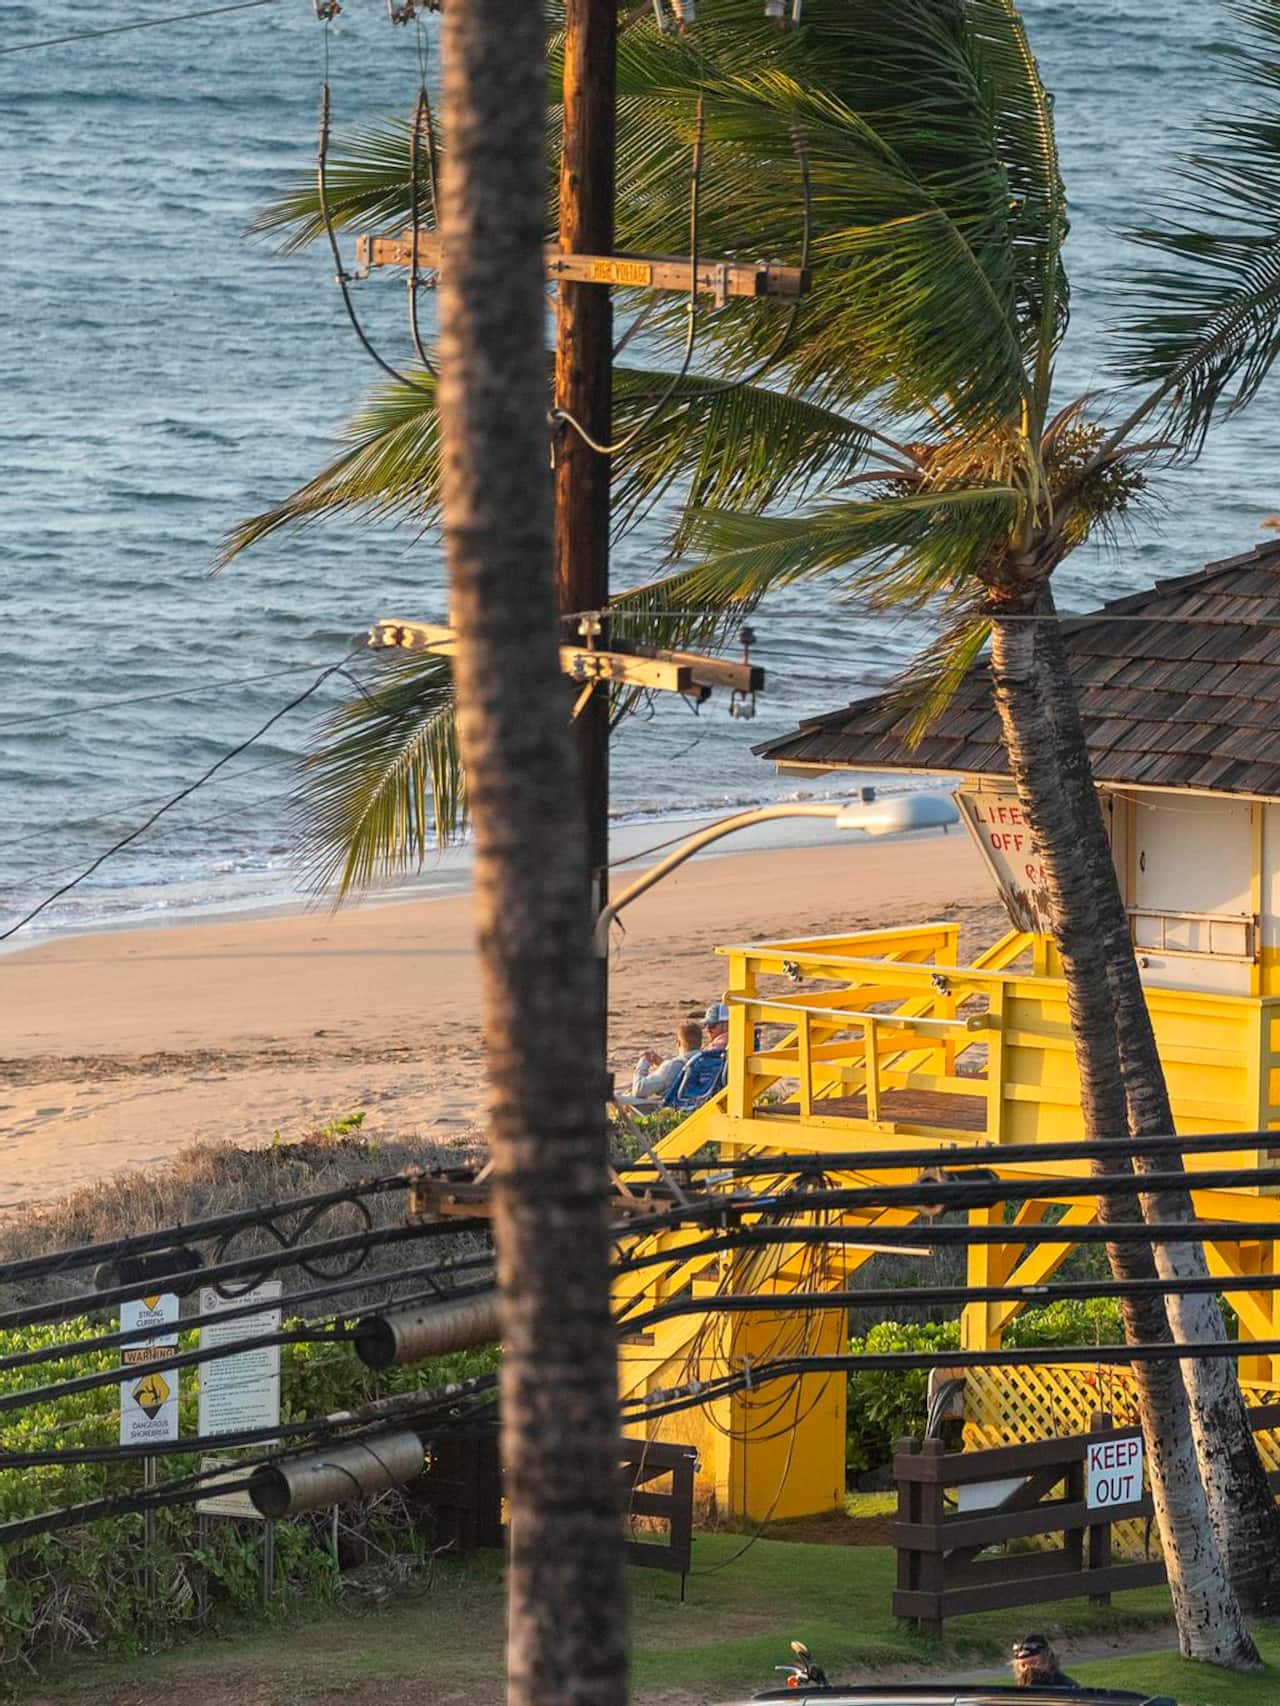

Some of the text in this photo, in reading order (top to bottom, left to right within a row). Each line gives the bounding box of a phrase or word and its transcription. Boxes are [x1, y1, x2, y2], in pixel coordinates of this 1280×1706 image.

[991, 833, 1023, 851] OFF
[126, 1348, 175, 1361] WARNING
[1091, 1442, 1138, 1471] KEEP
[1096, 1475, 1134, 1504] OUT
